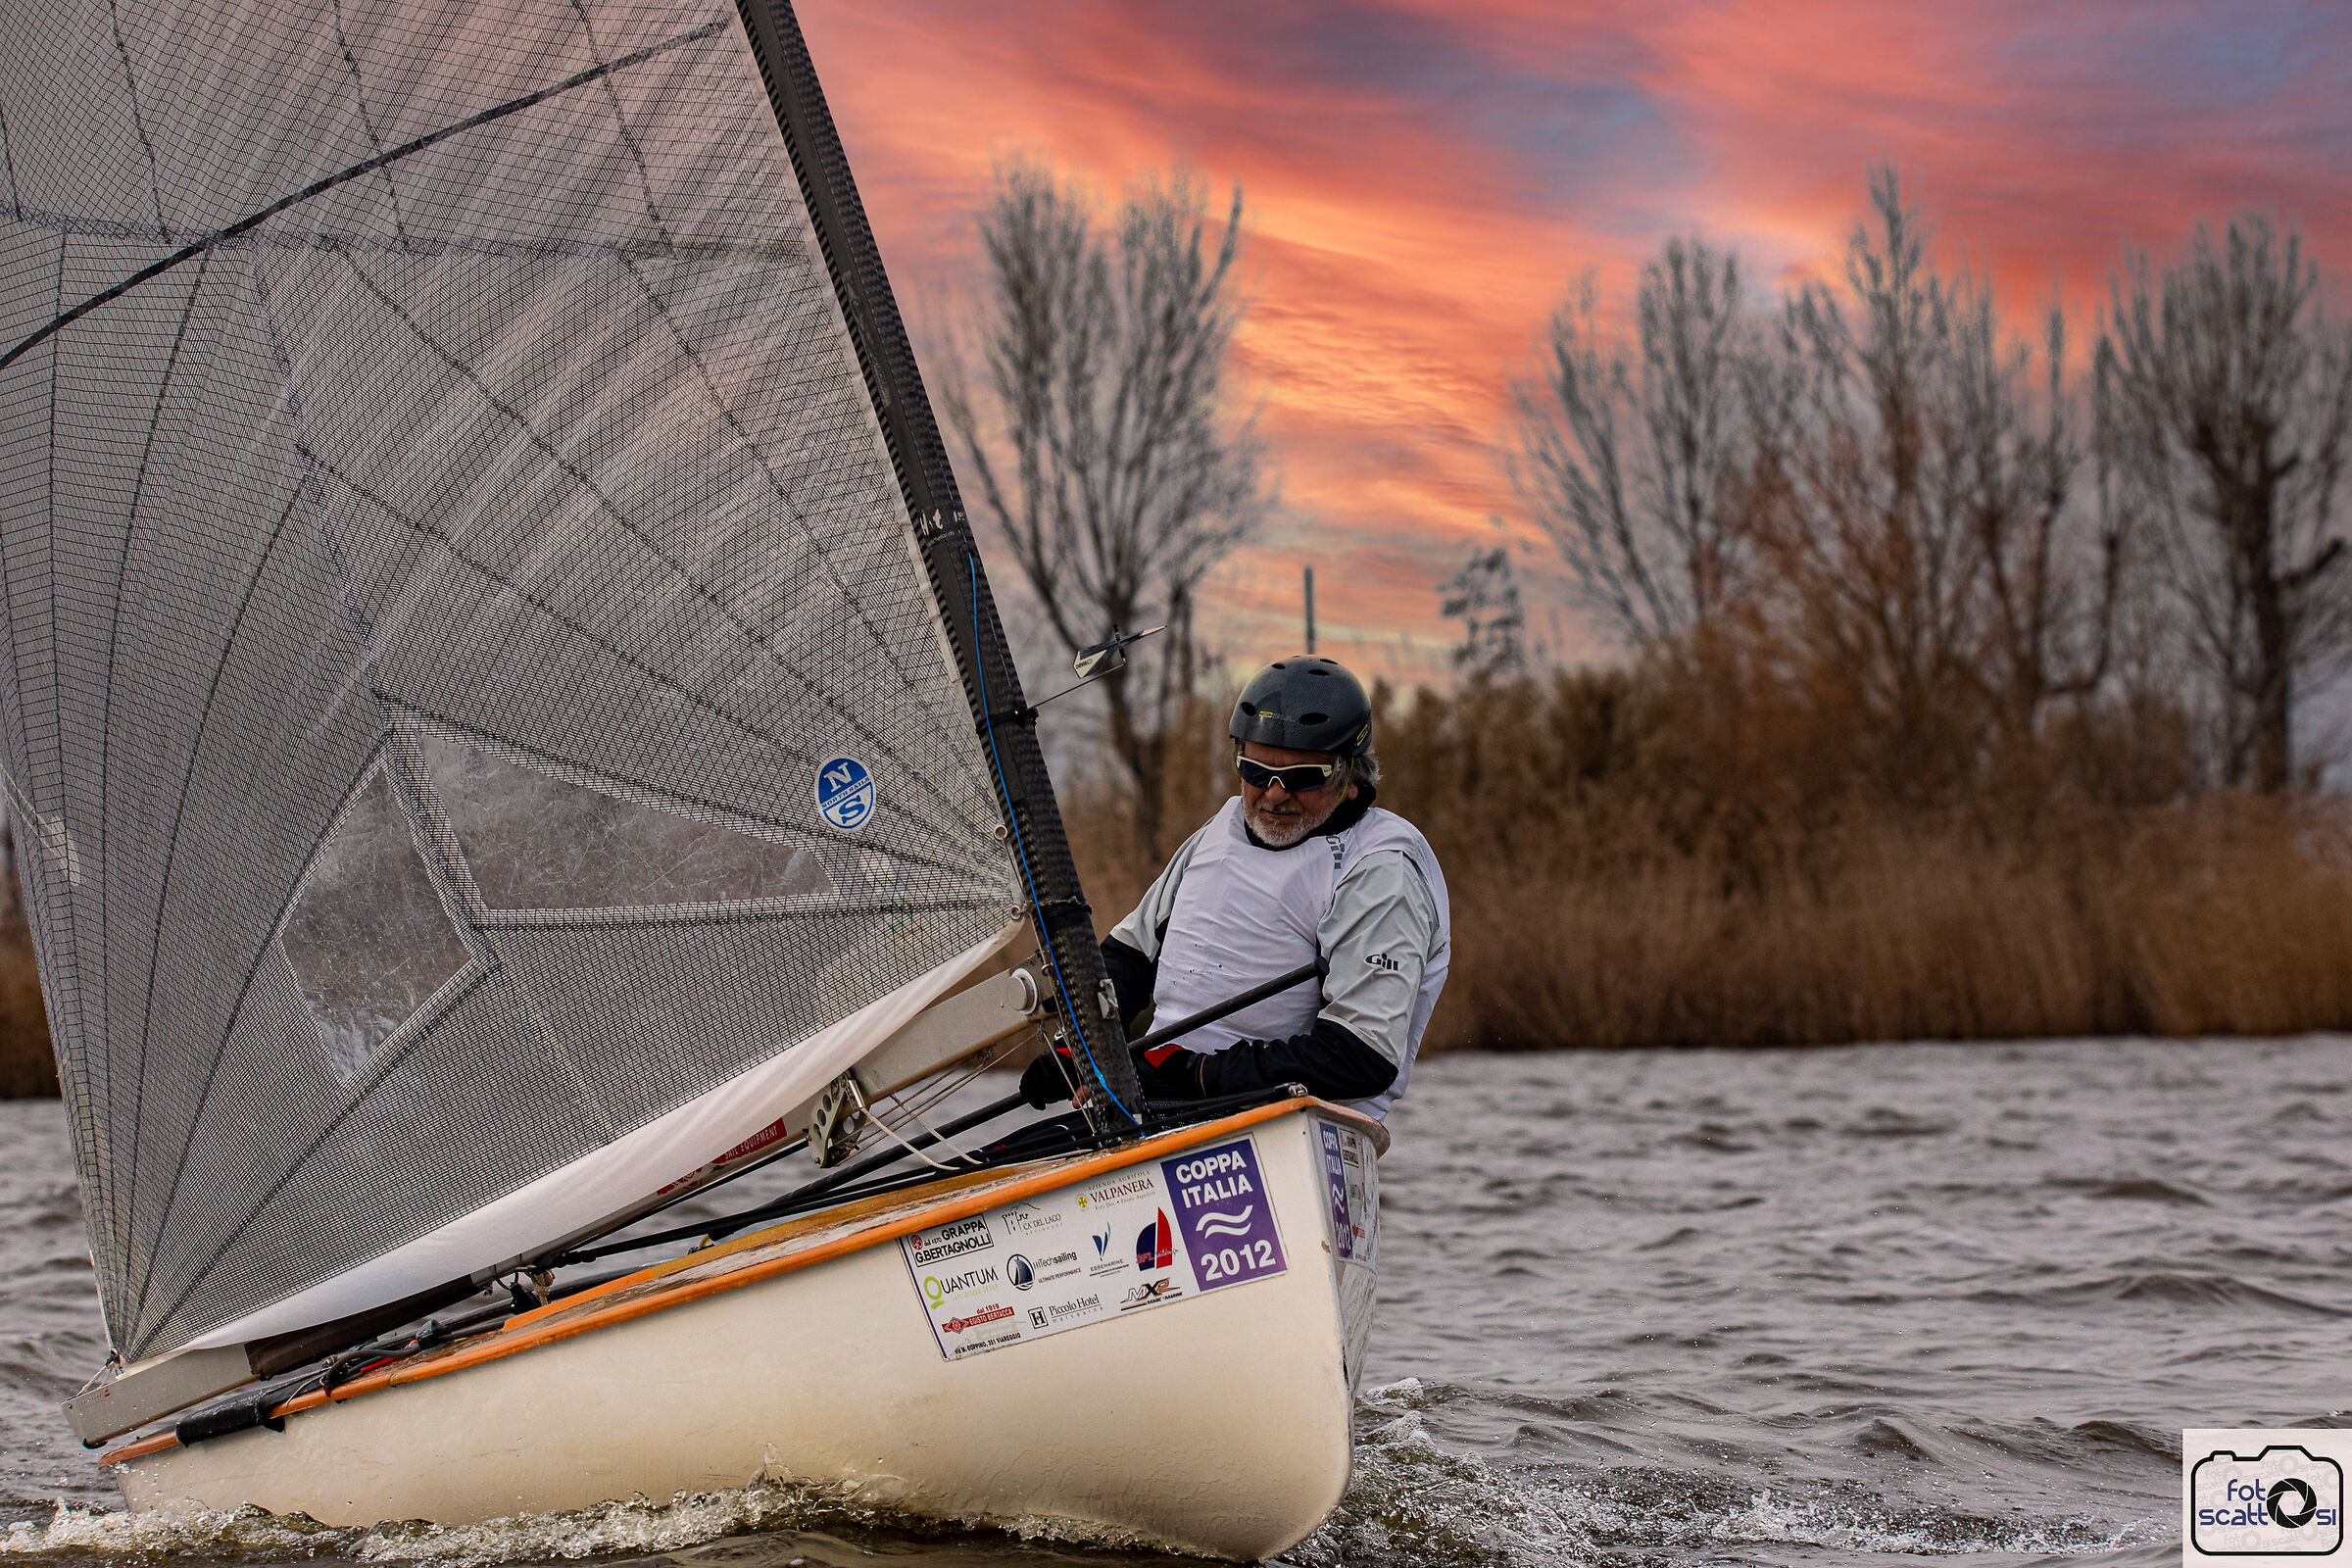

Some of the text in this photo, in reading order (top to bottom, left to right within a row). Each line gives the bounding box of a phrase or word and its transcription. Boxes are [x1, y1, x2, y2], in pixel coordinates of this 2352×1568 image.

[824, 762, 852, 792] N
[821, 777, 870, 808] NORTH SAILS
[839, 795, 864, 824] S
[1364, 953, 1398, 971] Gill
[740, 1125, 777, 1152] EQUIPMENT
[1176, 1151, 1247, 1184] COPPA
[1090, 1178, 1154, 1203] VALPANERA
[1181, 1173, 1253, 1208] ITALIA
[941, 1219, 986, 1241] GRAPPA
[1033, 1218, 1045, 1228] DEL
[1044, 1213, 1061, 1224] LAGO
[915, 1233, 991, 1263] G.BERTAGNOLLI
[1336, 1221, 1352, 1250] 2012
[1200, 1240, 1276, 1281] 2012
[924, 1266, 999, 1309] QUANTUM
[1049, 1294, 1100, 1315] Piccolo Hotel
